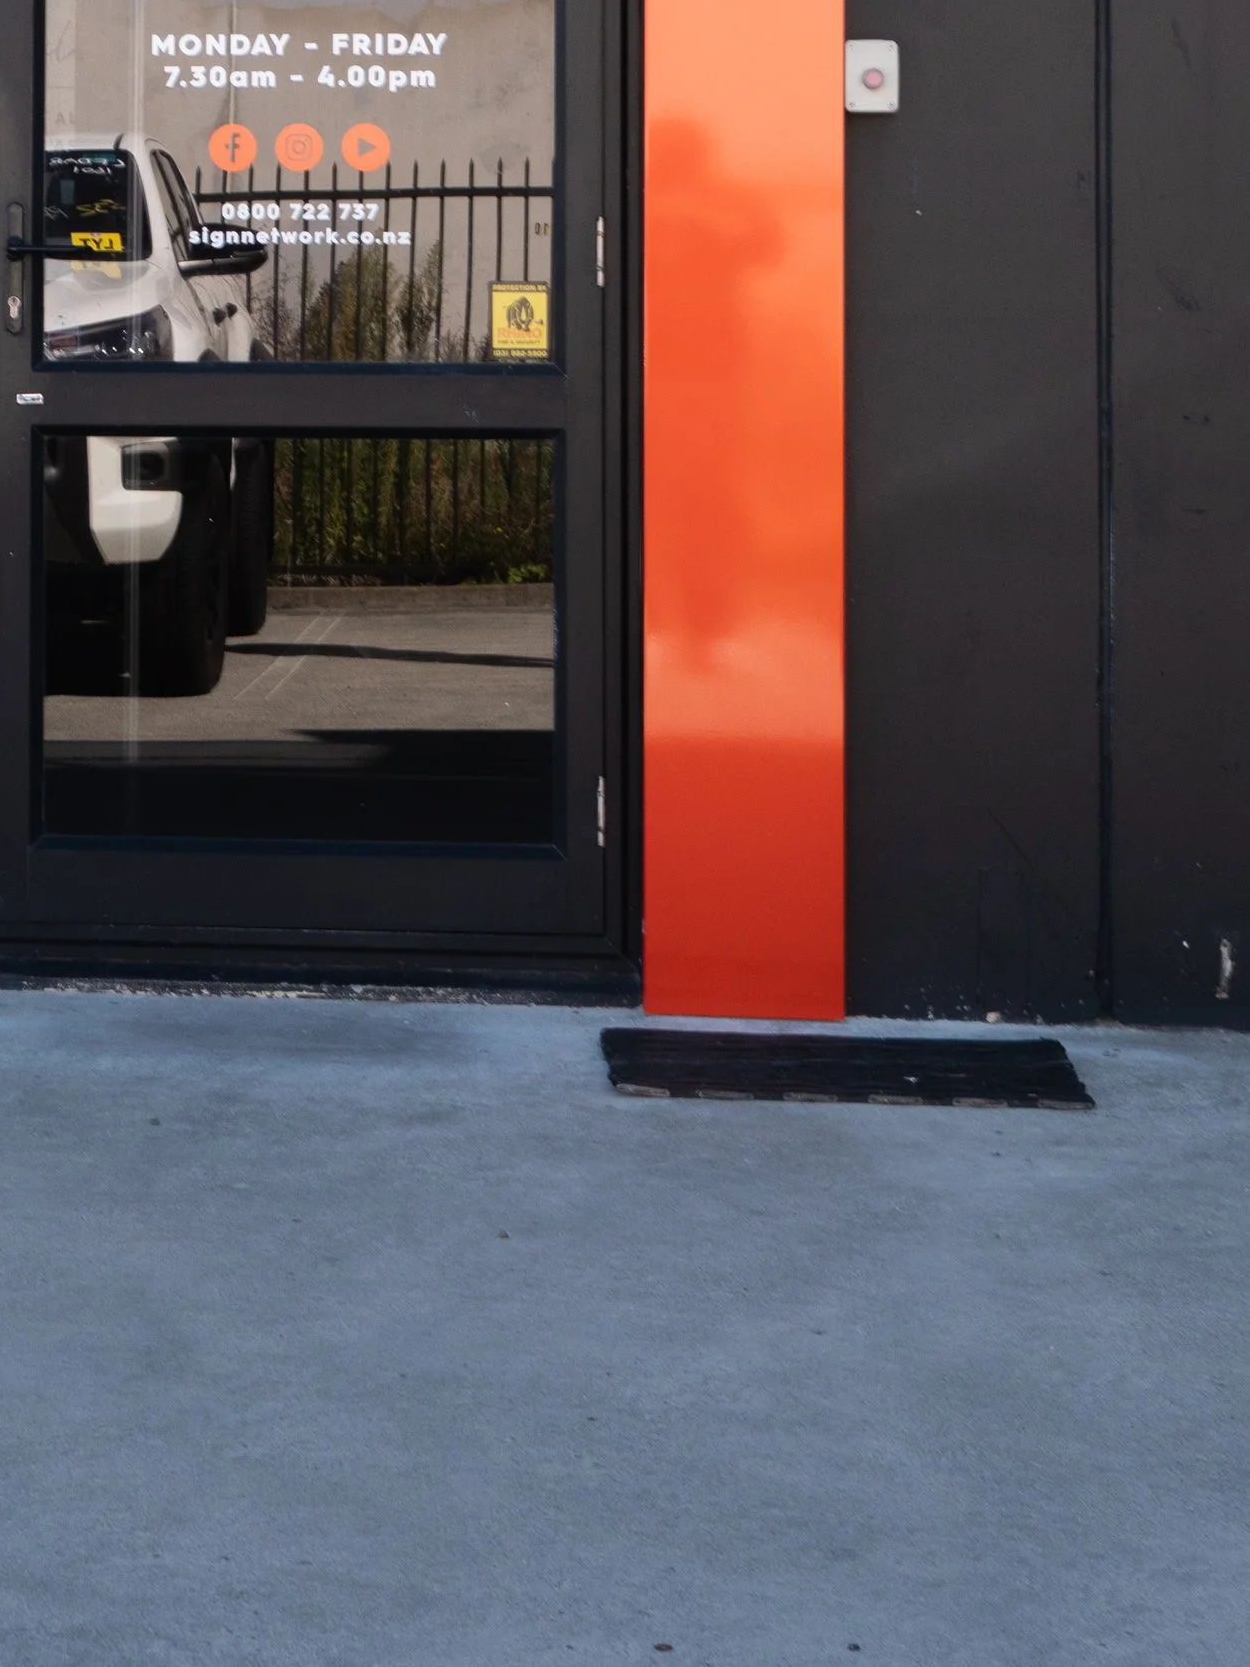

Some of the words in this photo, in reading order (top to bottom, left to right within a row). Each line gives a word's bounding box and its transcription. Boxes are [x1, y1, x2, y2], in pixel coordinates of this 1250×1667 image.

[151, 33, 290, 58] MONDAY
[331, 33, 448, 57] FRIDAY
[163, 65, 277, 89] 7.30am
[317, 65, 437, 92] 4.00pm
[221, 201, 280, 221] 0800
[289, 201, 330, 221] 722
[338, 201, 380, 221] 737
[188, 225, 412, 248] signnetwork.co.nz
[497, 327, 543, 339] RHINO
